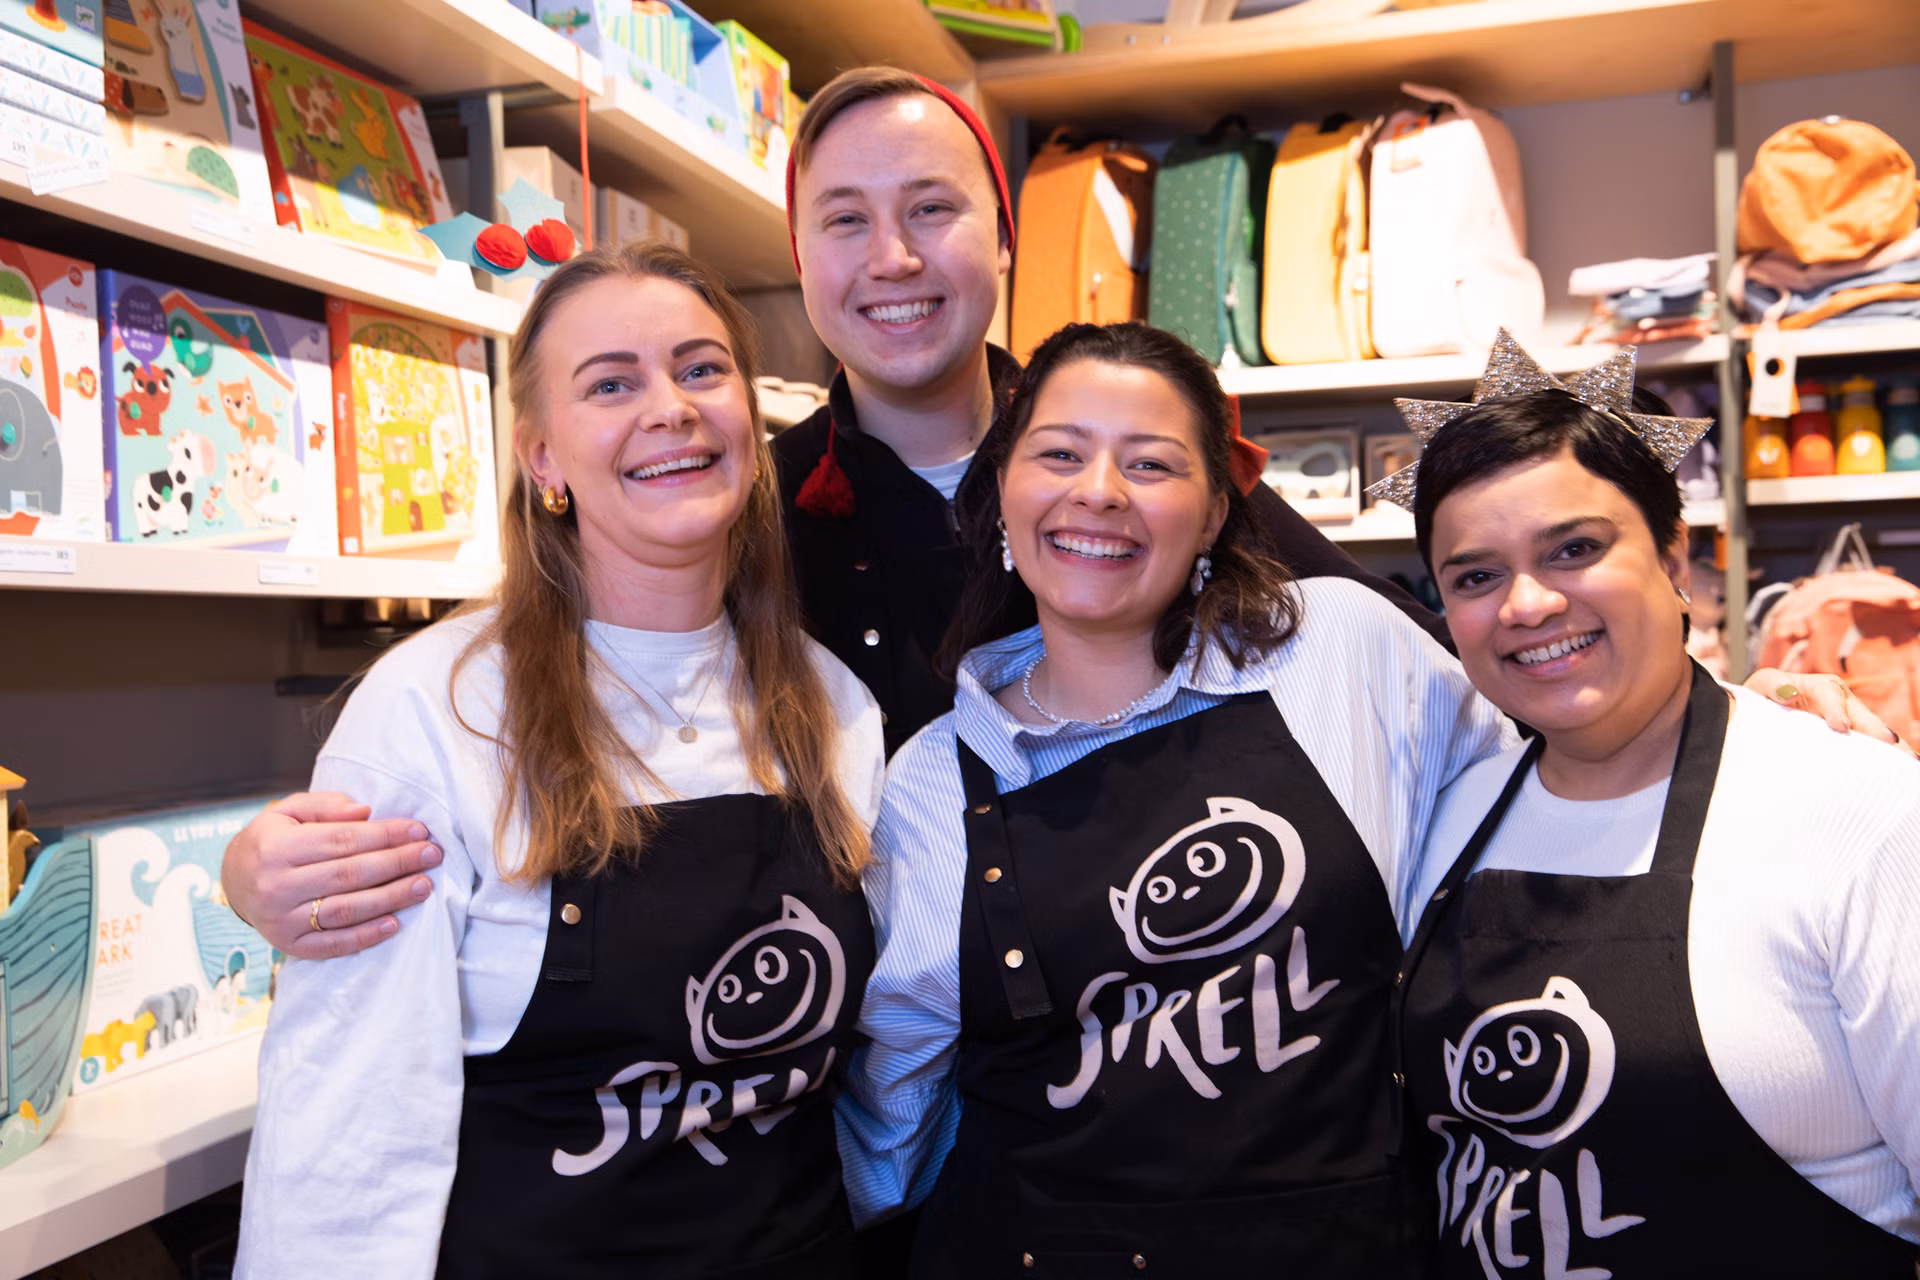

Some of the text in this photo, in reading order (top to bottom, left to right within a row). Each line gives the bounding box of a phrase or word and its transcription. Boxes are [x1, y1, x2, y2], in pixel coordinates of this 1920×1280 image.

[98, 913, 142, 941] REAT
[96, 943, 133, 968] ARK
[1046, 925, 1341, 1109] SPRELL
